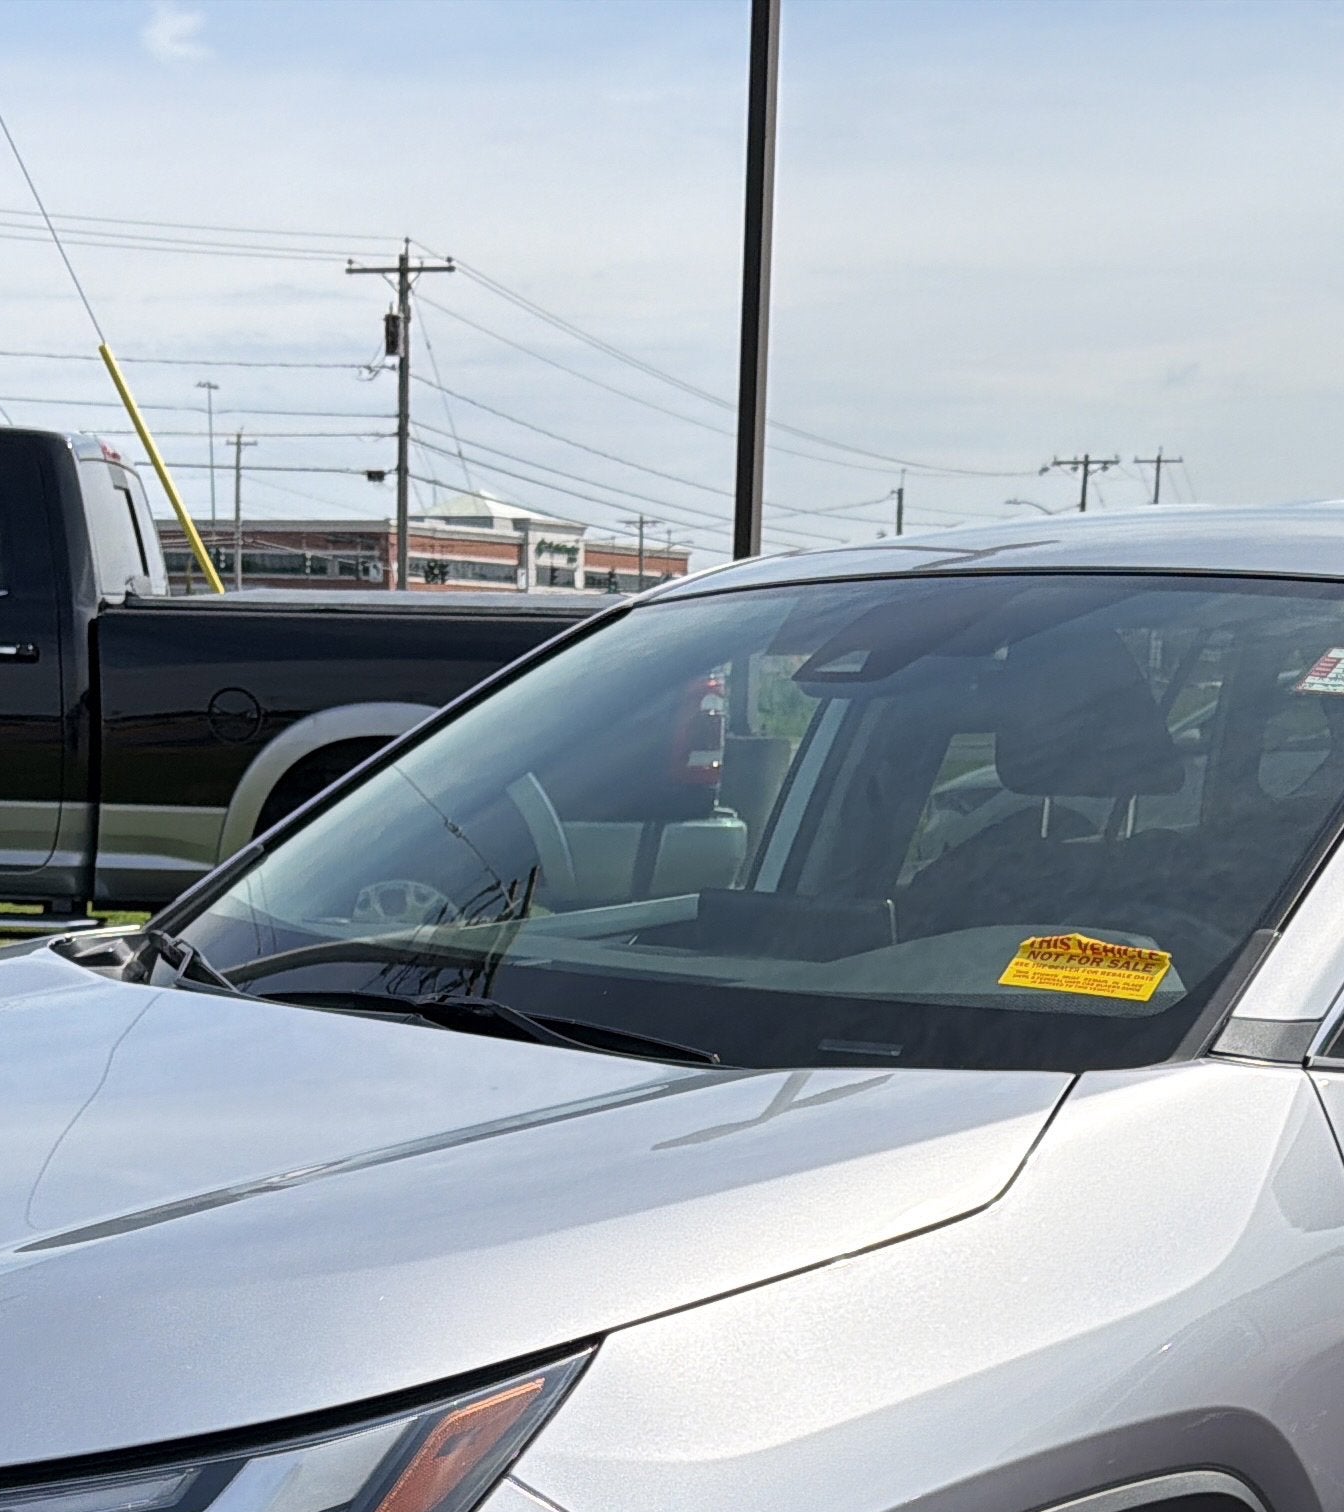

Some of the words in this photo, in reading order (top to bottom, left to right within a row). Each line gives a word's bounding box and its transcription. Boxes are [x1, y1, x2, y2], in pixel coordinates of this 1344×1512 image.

[1029, 936, 1073, 952] THIS
[1077, 938, 1162, 962] VEHICLE
[1026, 950, 1062, 963] NOT
[1065, 954, 1104, 968] FOR
[1109, 959, 1157, 973] SALE
